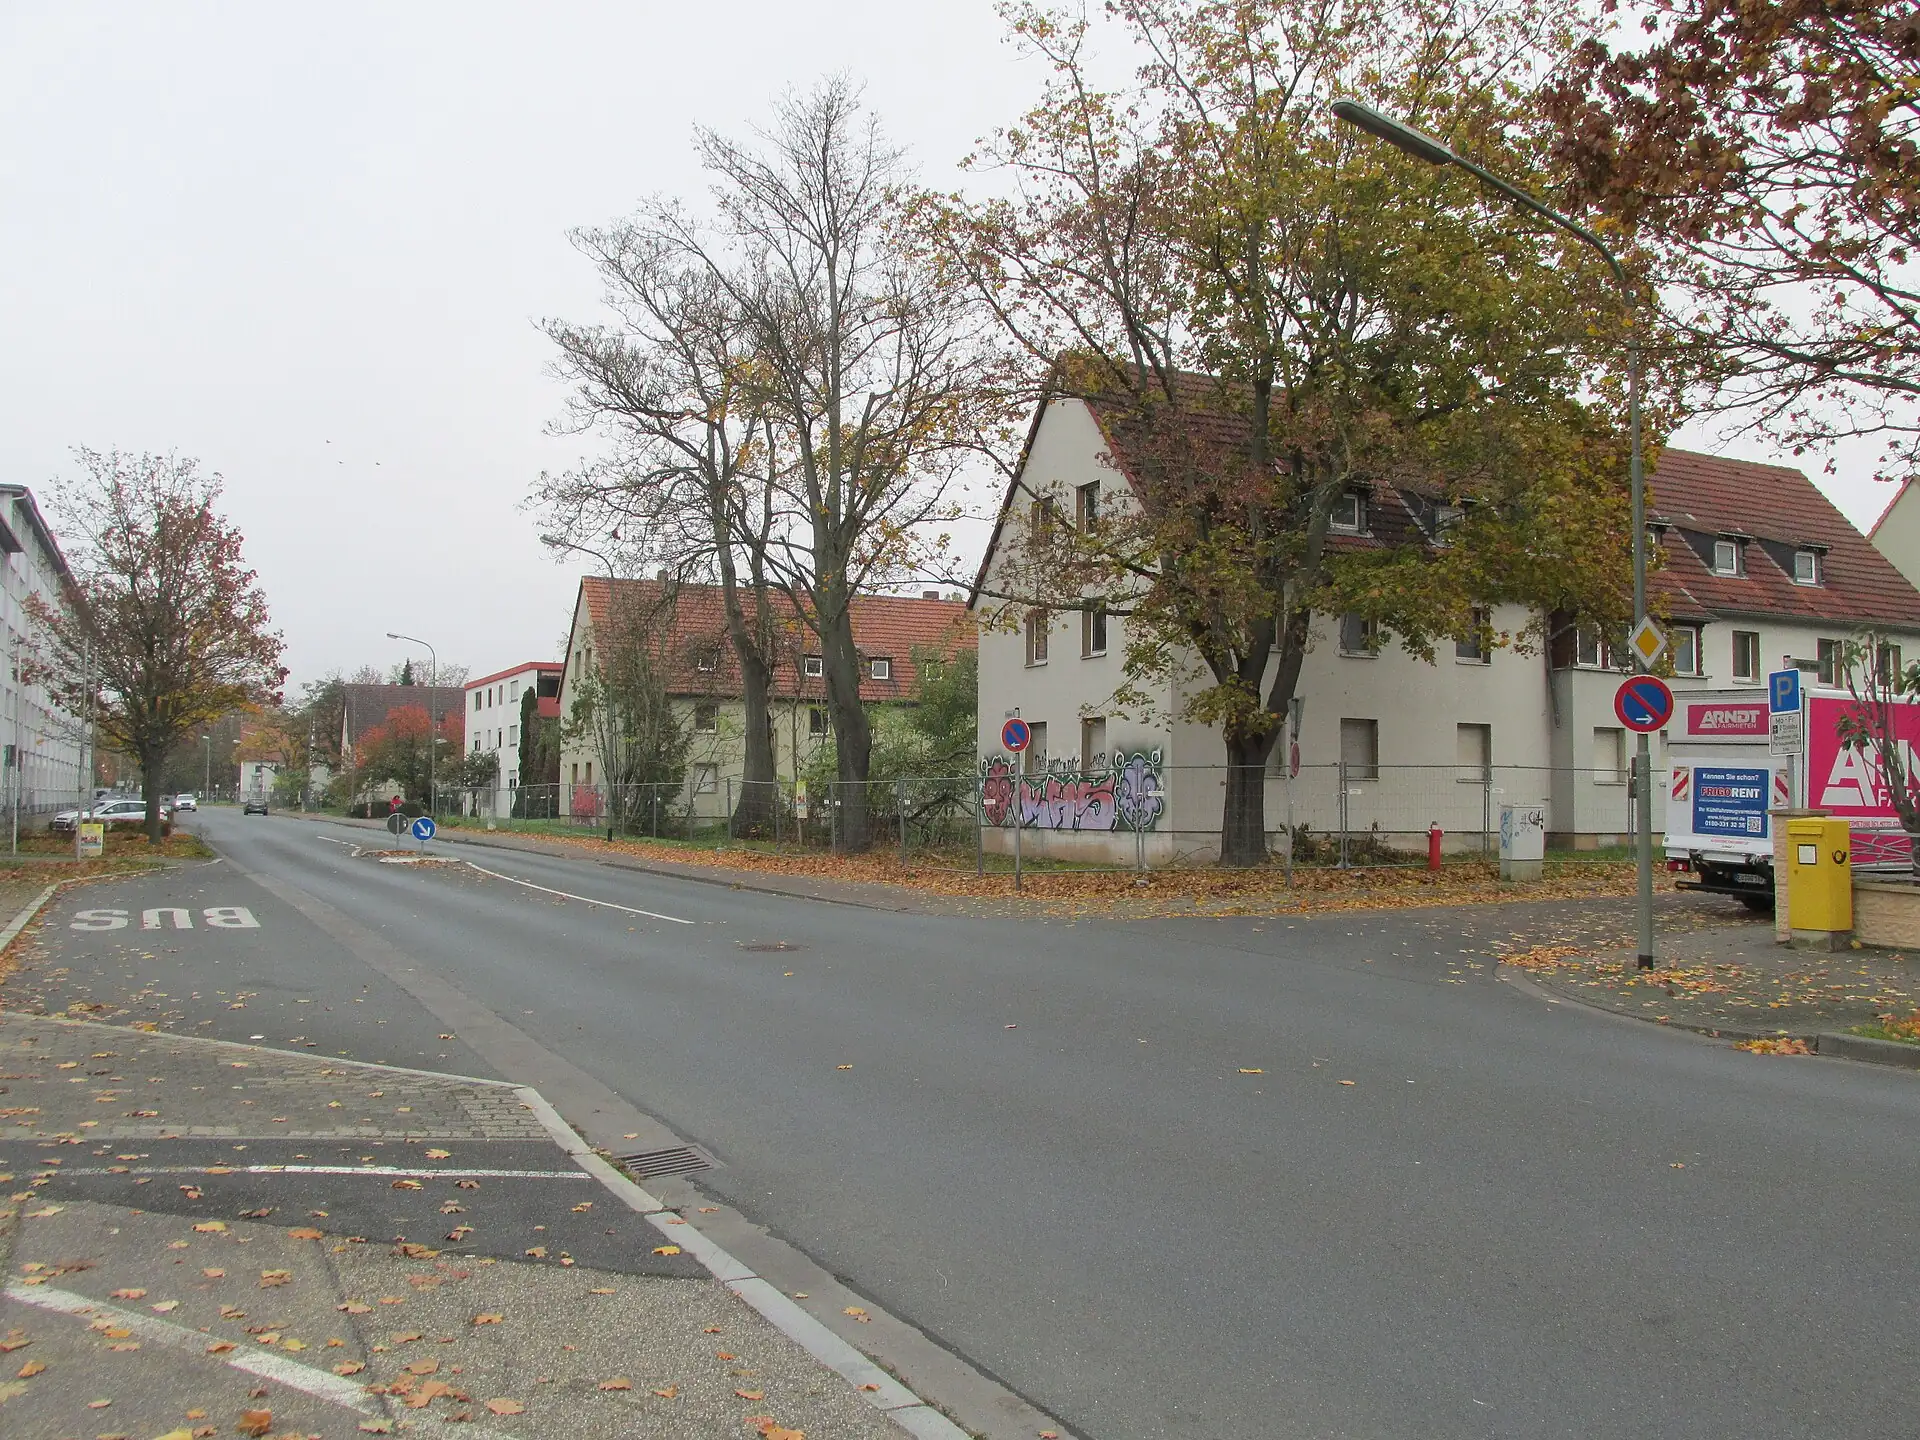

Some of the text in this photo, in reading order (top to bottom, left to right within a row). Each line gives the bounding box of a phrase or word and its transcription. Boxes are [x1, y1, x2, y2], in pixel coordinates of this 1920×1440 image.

[1776, 675, 1793, 708] P
[1698, 710, 1761, 729] ARNDT
[1701, 786, 1760, 798] FRIGORENT
[69, 906, 261, 931] BUS
